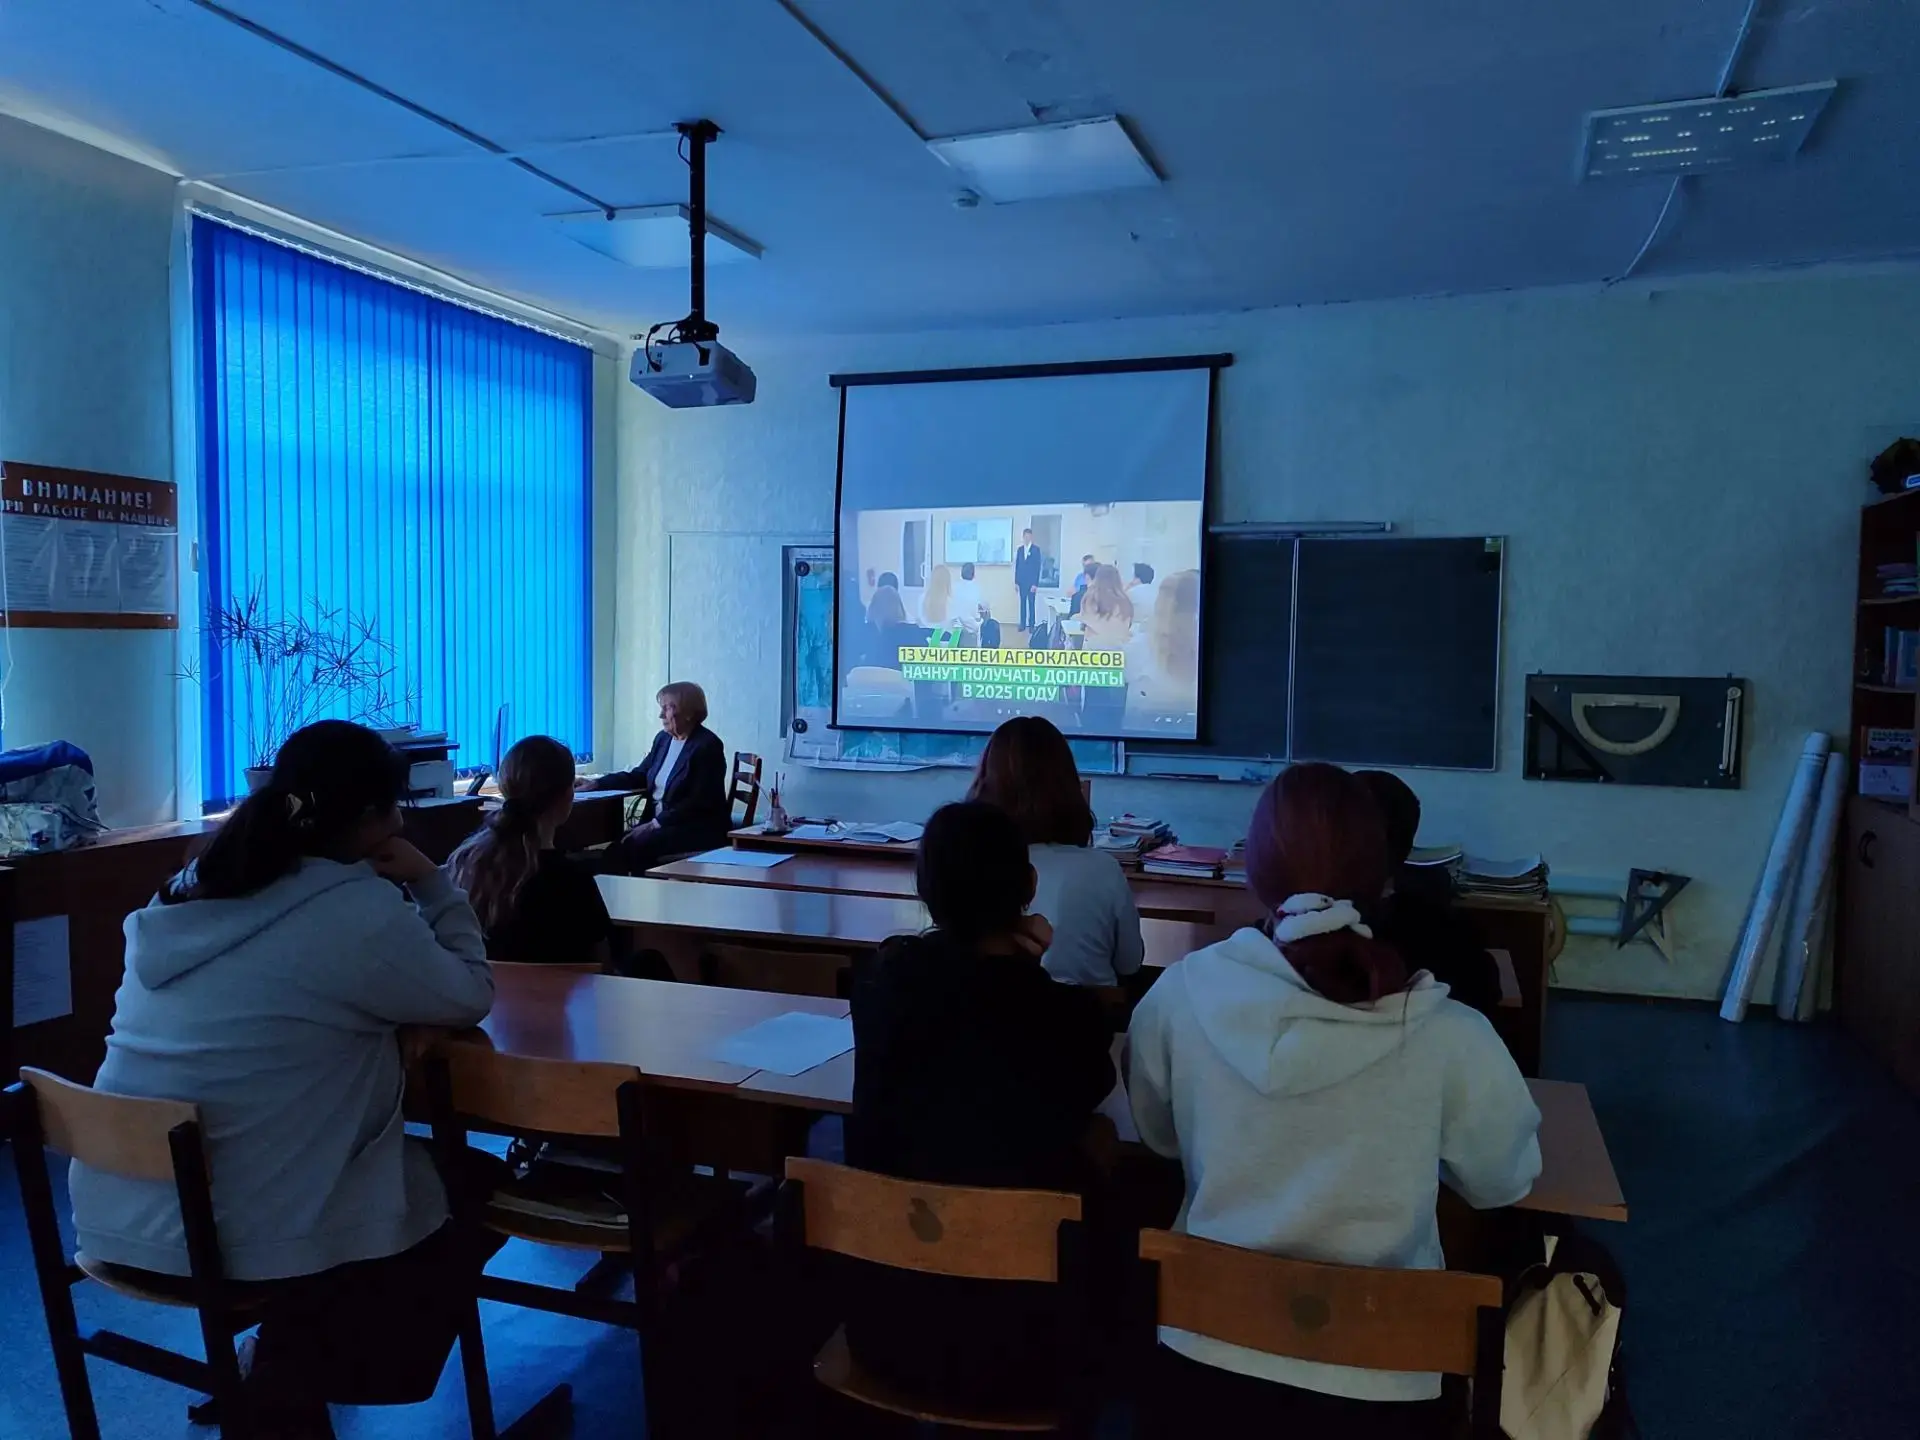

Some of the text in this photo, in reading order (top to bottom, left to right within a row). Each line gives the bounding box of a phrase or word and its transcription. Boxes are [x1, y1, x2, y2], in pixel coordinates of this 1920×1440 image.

[22, 478, 152, 510] ВНИМАНИЕ!
[33, 502, 88, 518] РАБОТЕ
[97, 508, 114, 521] НА
[901, 648, 915, 661] 13
[1004, 650, 1123, 667] АГРОКЛАССОВ
[903, 665, 1123, 685] НАЧНУТ ПОЛУЧАТЬ ДОПЛАТЫ
[962, 684, 1058, 702] В 2025 ГОДУ
